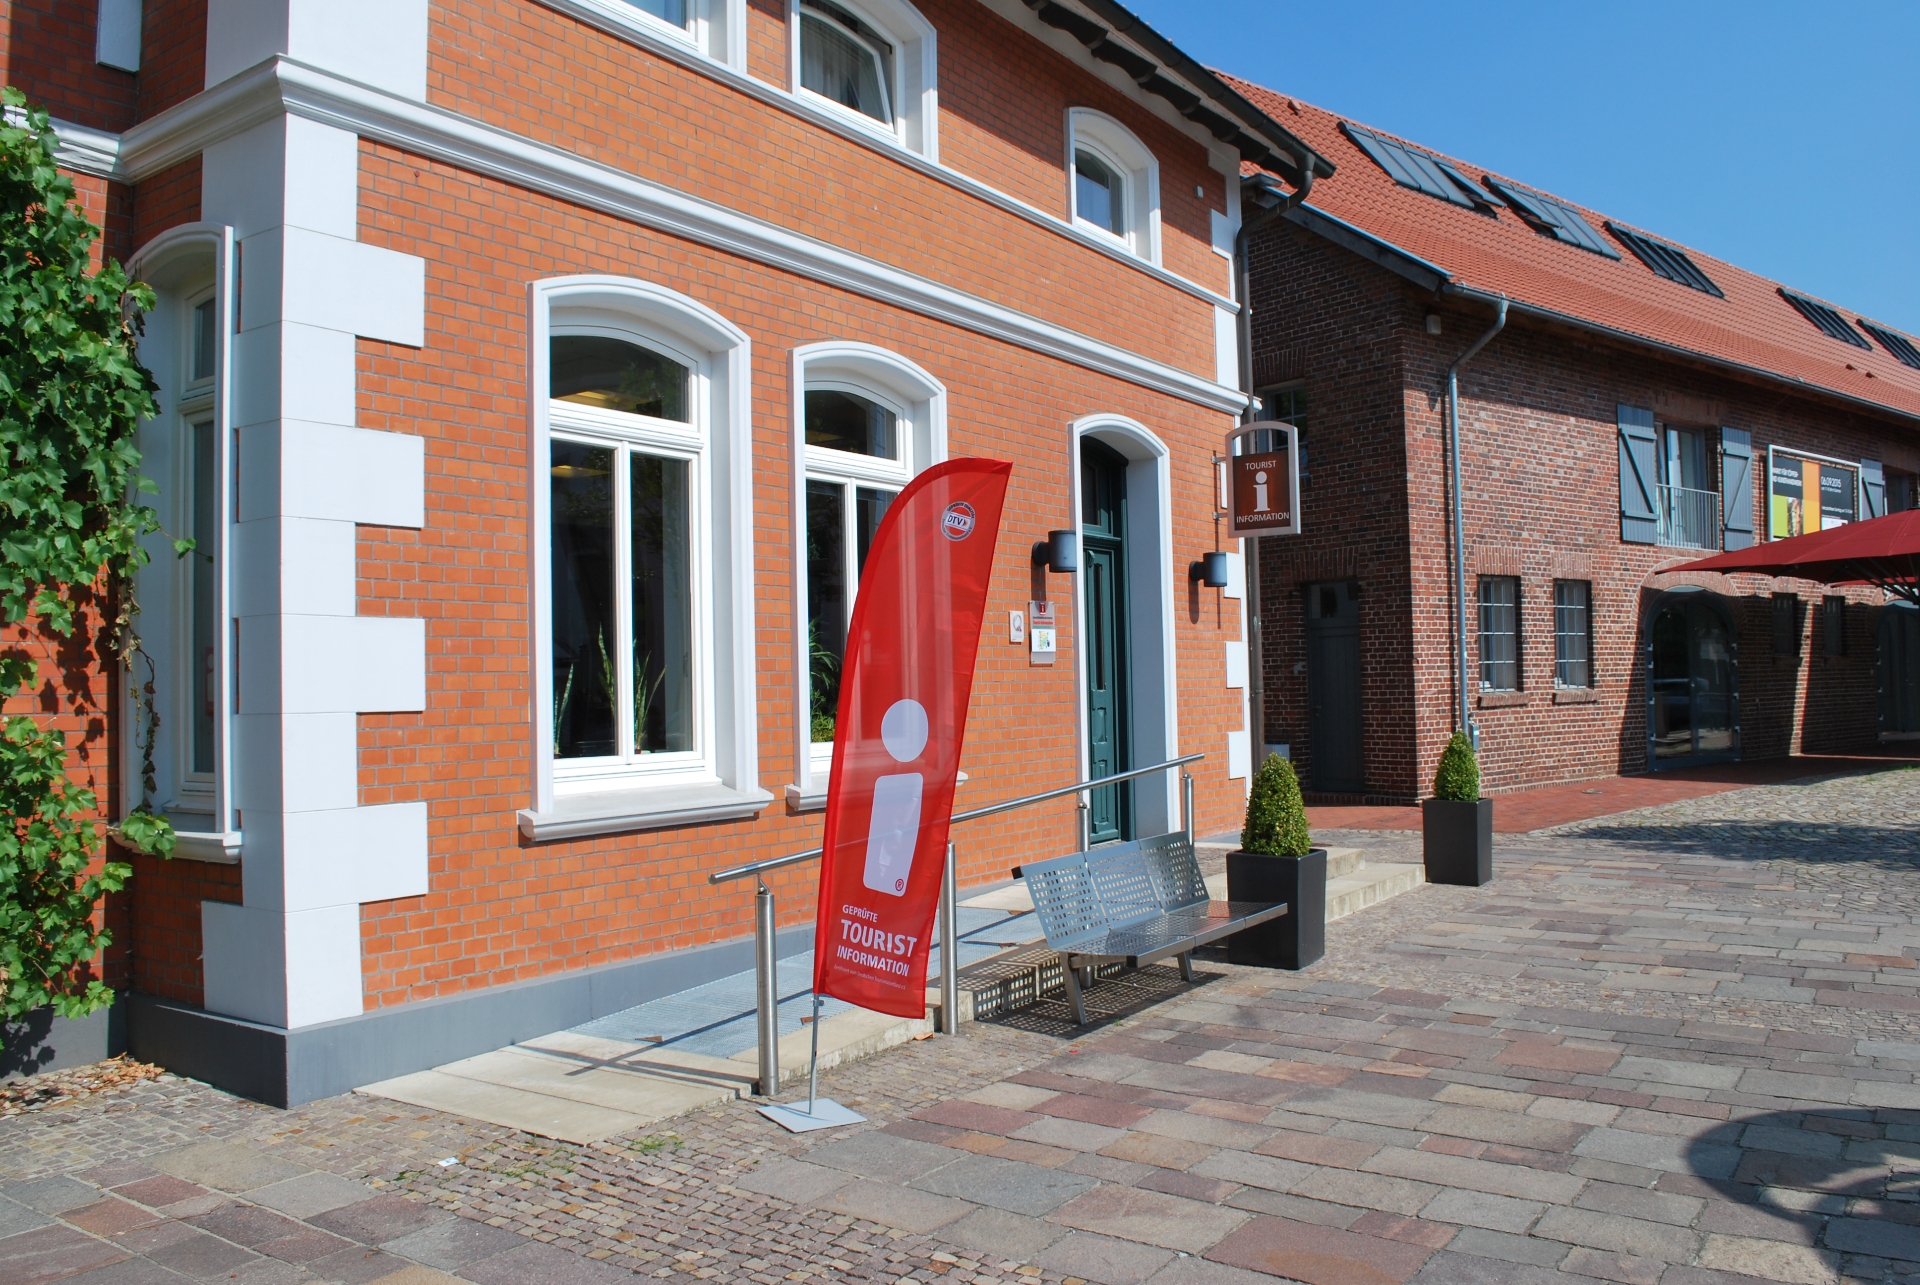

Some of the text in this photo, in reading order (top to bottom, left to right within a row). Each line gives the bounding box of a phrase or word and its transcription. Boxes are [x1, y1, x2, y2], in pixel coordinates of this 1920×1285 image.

[1245, 460, 1276, 470] TOURIST
[947, 515, 963, 526] DTV
[1236, 512, 1289, 523] INFORMATION
[842, 904, 878, 923] GEPRÜFTE
[841, 919, 917, 957] TOURIST
[837, 945, 910, 977] INFORMATION
